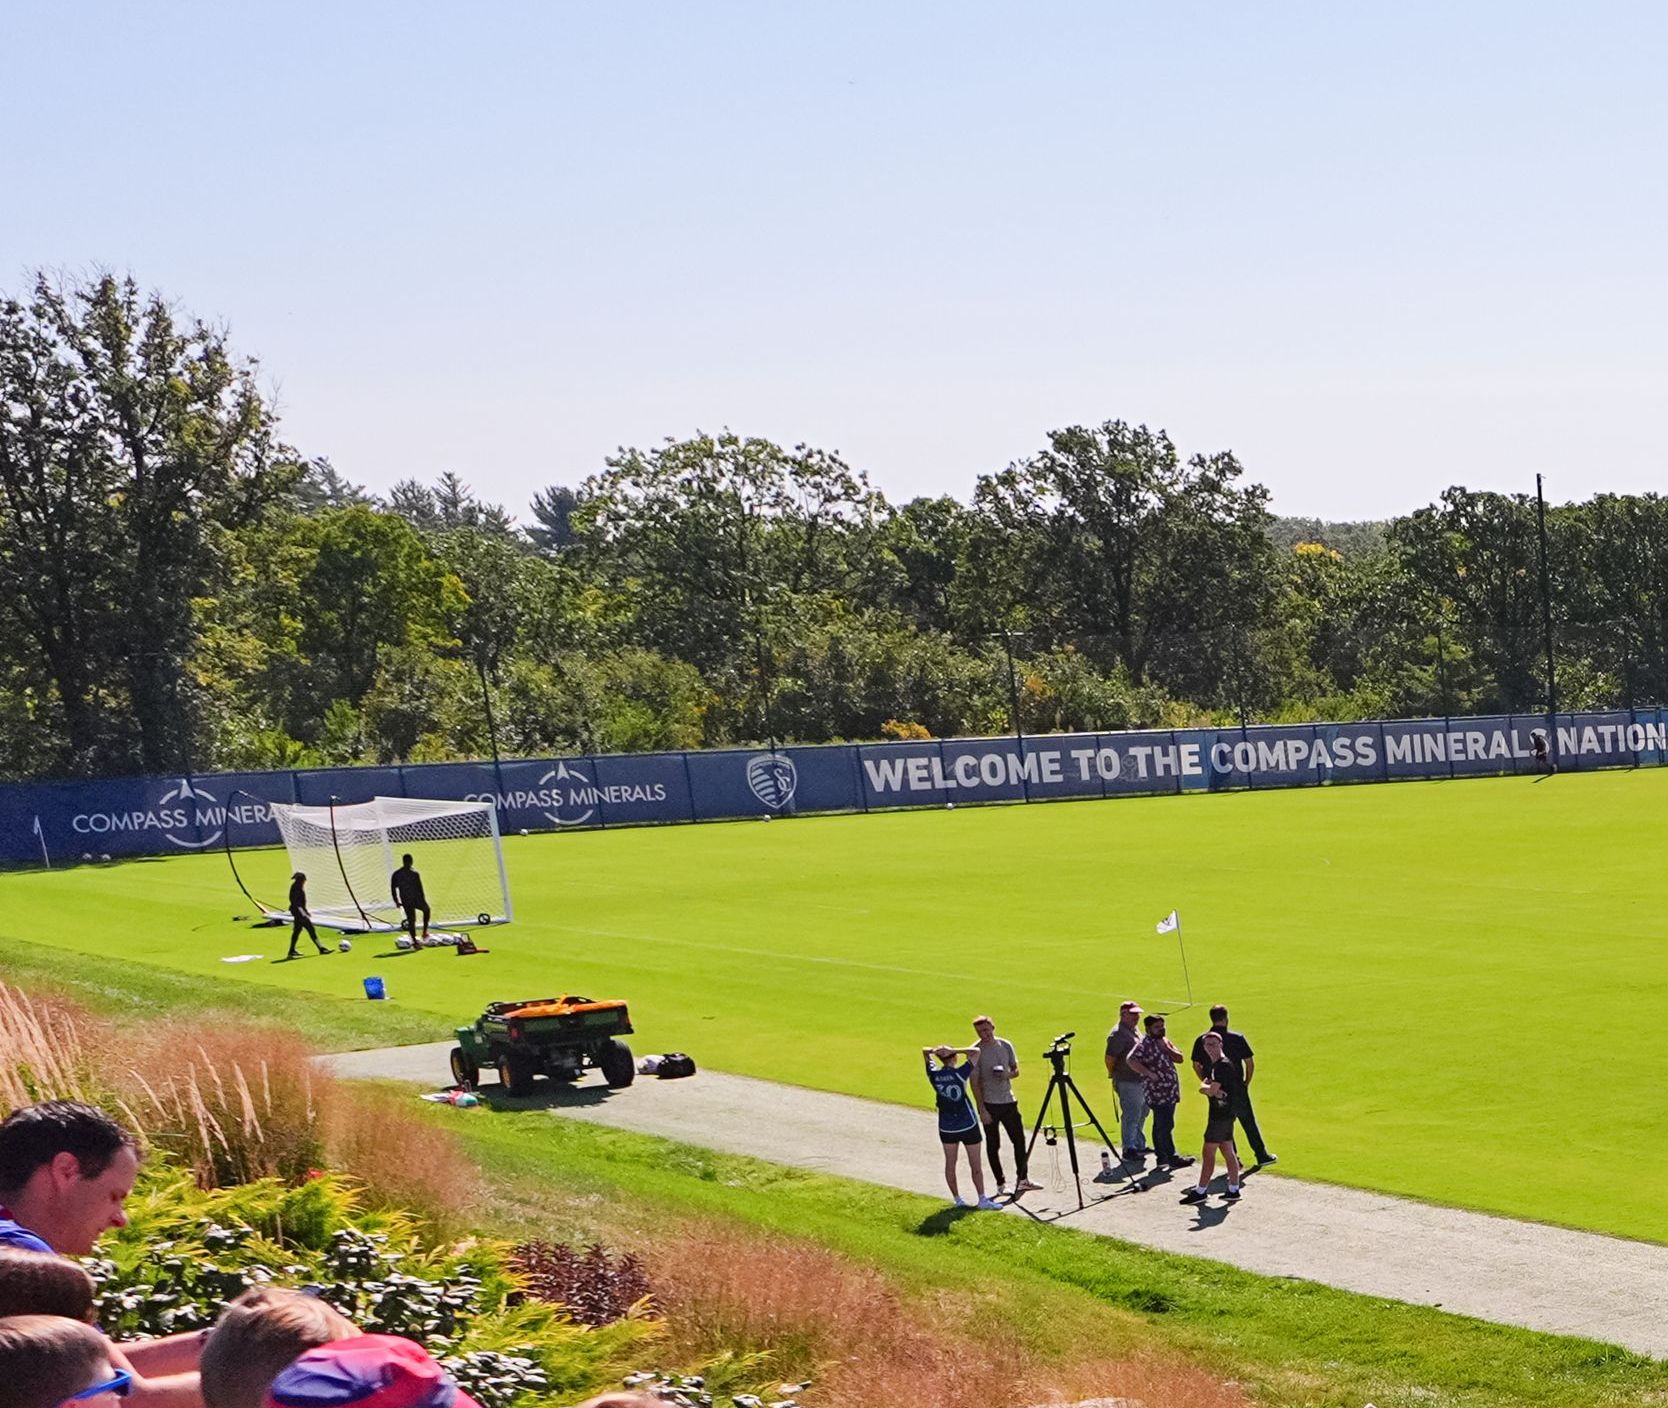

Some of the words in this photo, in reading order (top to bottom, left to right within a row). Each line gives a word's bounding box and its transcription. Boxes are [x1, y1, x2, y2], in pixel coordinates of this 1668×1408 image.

[863, 749, 1064, 793] WELCOME
[1072, 746, 1121, 782] TO
[1128, 743, 1204, 778] THE
[1210, 734, 1377, 774] COMPASS
[1385, 726, 1551, 766] MINERALS
[570, 783, 667, 806] MINERALS
[72, 809, 188, 833] COMPASS
[195, 804, 280, 827] MINERA
